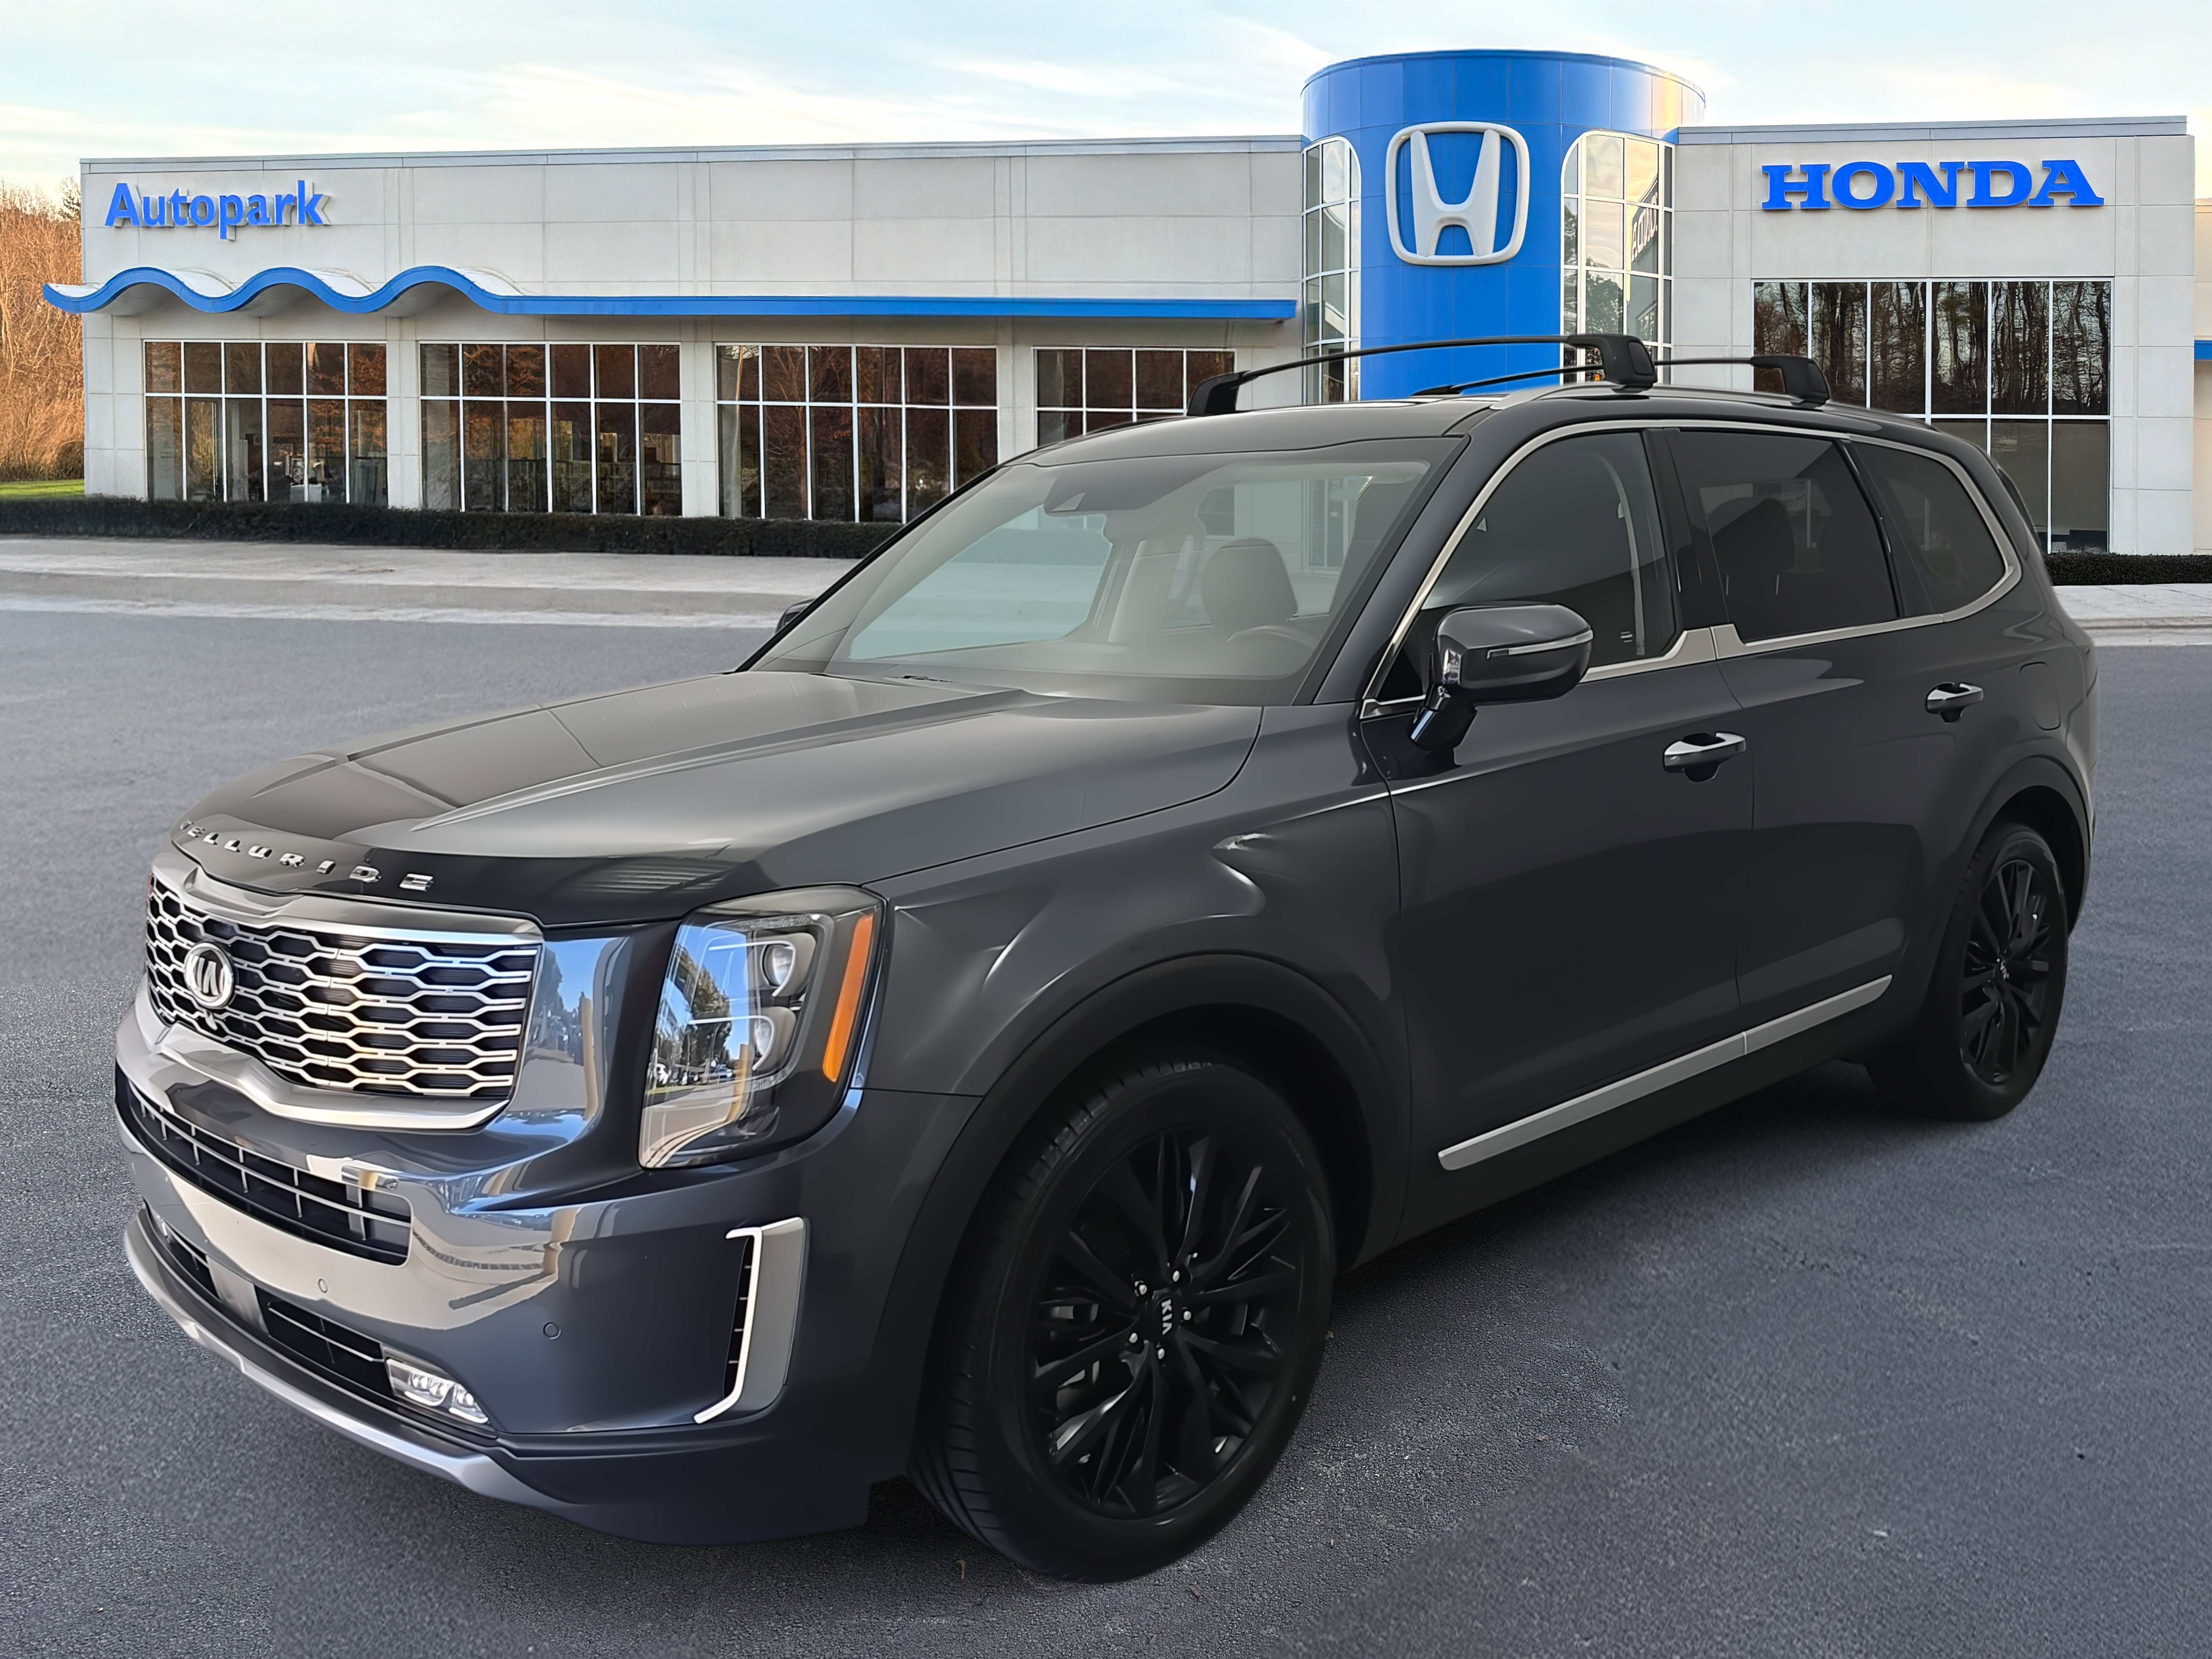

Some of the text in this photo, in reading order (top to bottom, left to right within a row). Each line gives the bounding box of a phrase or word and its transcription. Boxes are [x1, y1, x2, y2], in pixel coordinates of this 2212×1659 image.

[105, 180, 329, 240] Autopark
[1762, 160, 2104, 210] HONDA
[1161, 1299, 1173, 1335] KIA
